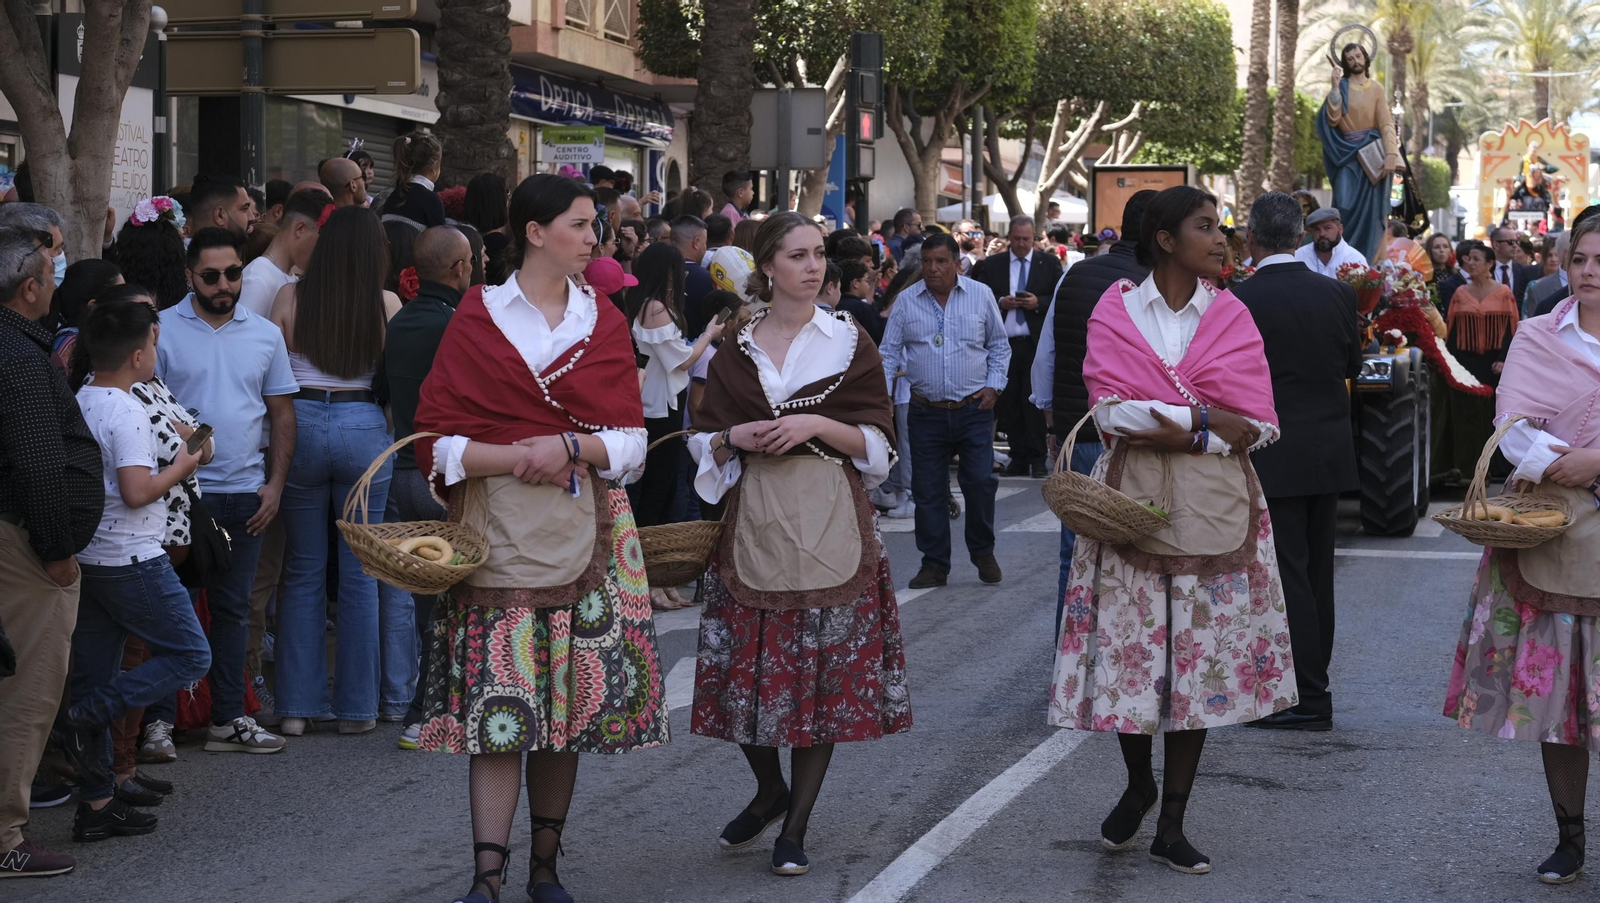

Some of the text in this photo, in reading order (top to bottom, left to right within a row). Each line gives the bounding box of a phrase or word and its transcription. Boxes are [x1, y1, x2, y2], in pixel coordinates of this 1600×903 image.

[117, 120, 148, 143] STIVAL
[114, 146, 148, 169] EATRO
[0, 850, 31, 871] N
